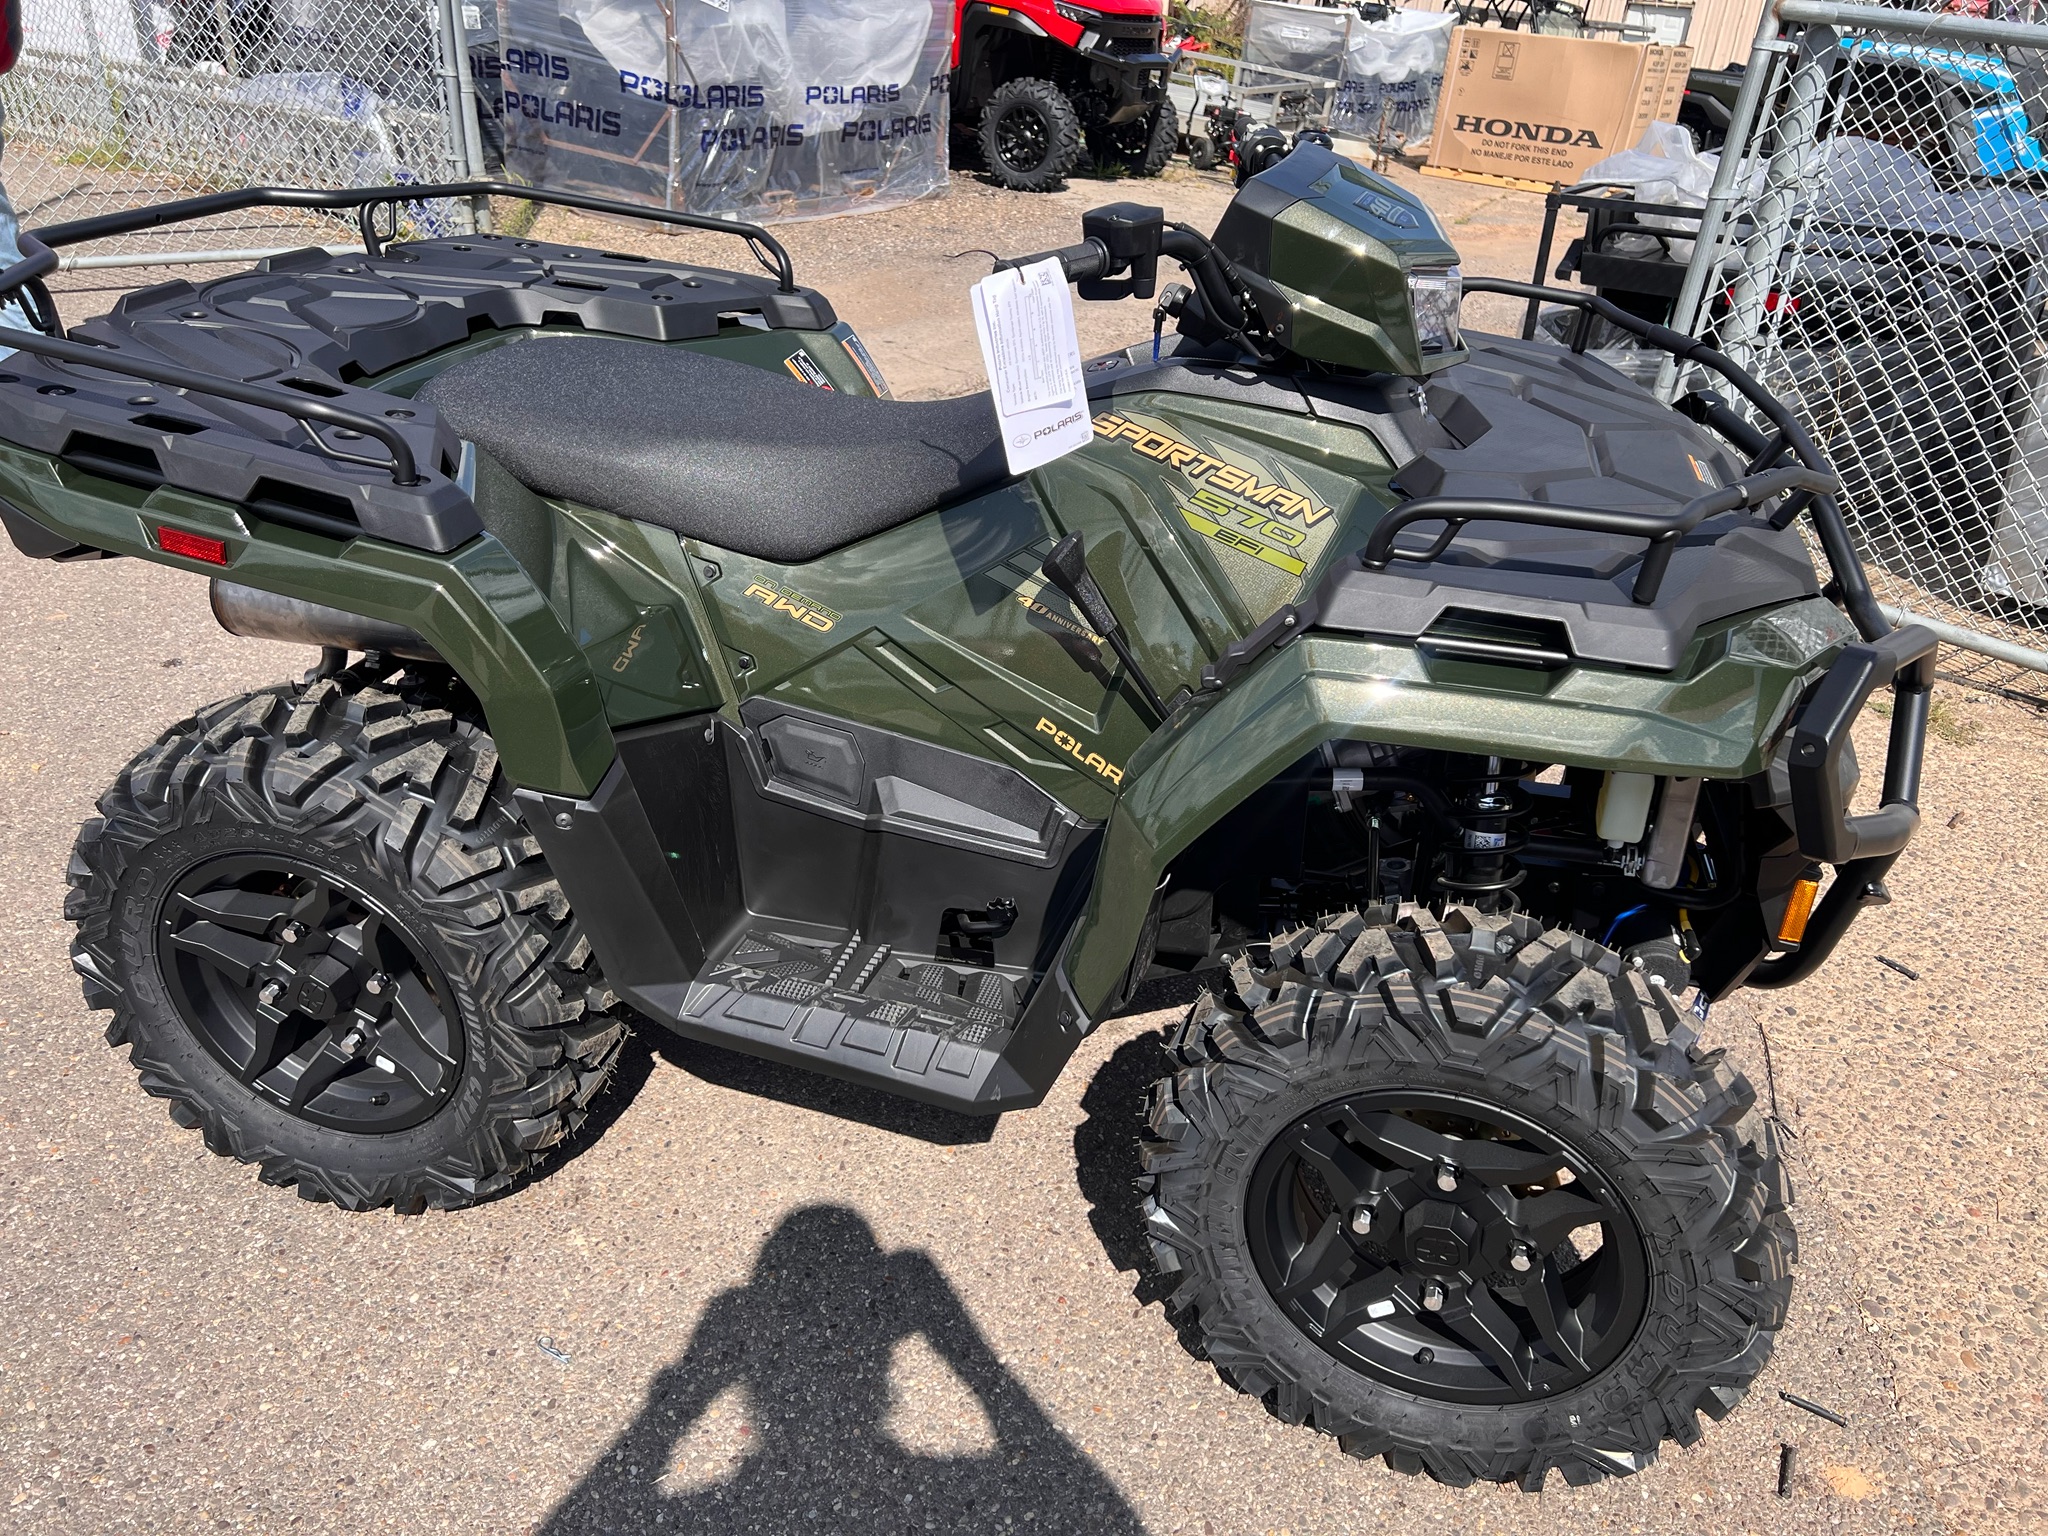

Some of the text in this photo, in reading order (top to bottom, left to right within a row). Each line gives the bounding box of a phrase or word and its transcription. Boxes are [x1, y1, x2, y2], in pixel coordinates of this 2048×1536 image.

[501, 48, 570, 81] ARIS
[806, 84, 900, 105] POLARIS
[504, 91, 621, 137] POLARIS
[841, 113, 931, 143] POLARIS
[701, 124, 804, 153] POLARIS
[1453, 114, 1603, 149] HONDA
[1482, 139, 1567, 157] DO NOT FORK THIS END
[1471, 148, 1574, 169] NO MANEJE POR ESTE LADO
[1033, 411, 1083, 440] POLARIS
[1091, 411, 1335, 529] SPORTSMAN
[1188, 488, 1307, 549] 570
[1213, 529, 1265, 556] EFI
[742, 583, 835, 633] AWD
[1016, 594, 1106, 646] 40 ANNIVERSARY
[1035, 716, 1124, 786] POLAR
